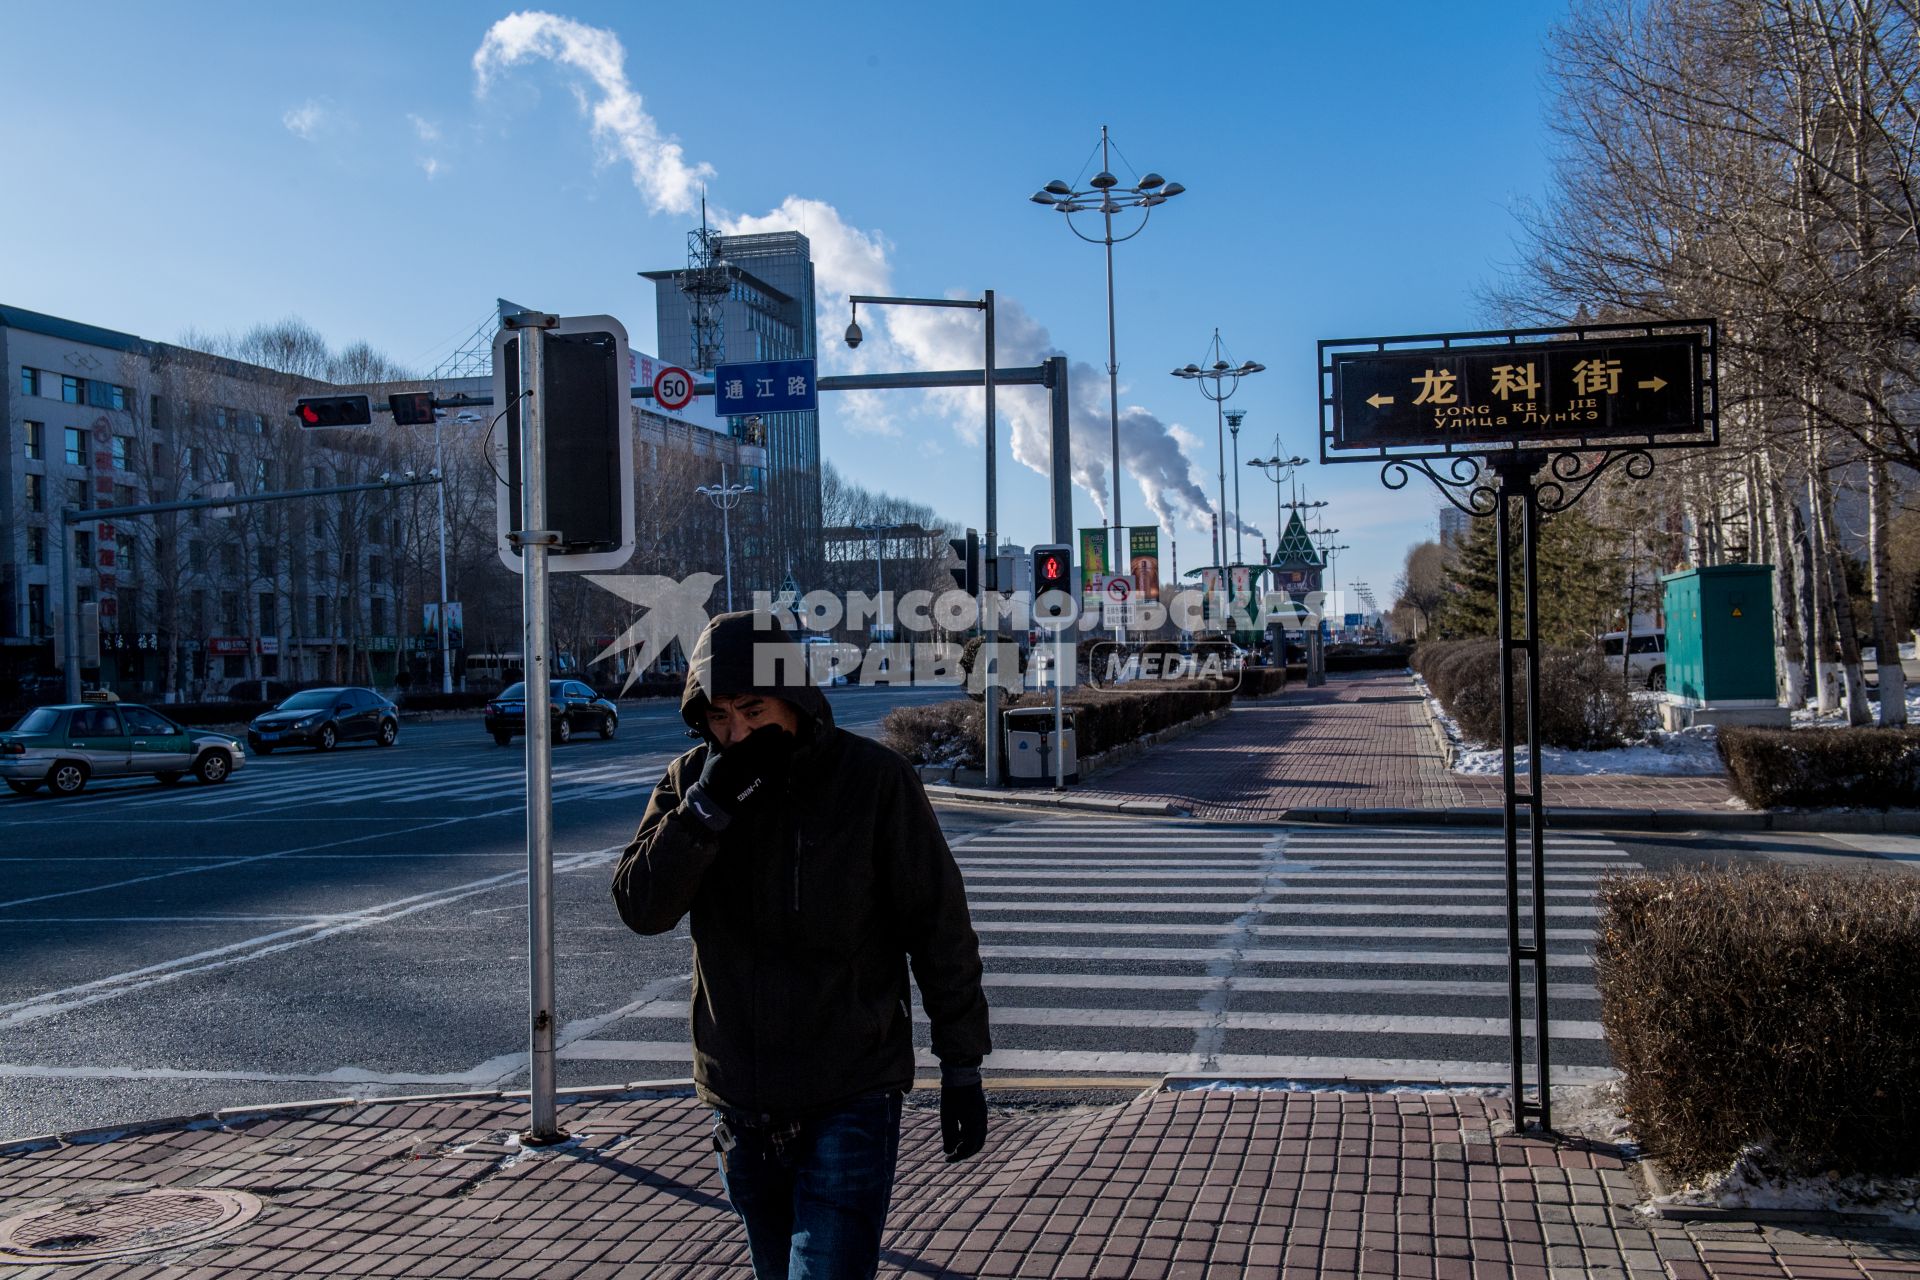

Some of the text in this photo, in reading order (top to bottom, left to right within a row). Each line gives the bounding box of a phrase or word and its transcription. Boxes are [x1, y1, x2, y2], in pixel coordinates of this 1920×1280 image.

[662, 379, 686, 398] 50
[724, 376, 807, 400] 通江路
[1411, 359, 1623, 406] 龙科街
[1434, 398, 1598, 417] LONG KE JIE
[1434, 410, 1599, 429] Улица Лункэ
